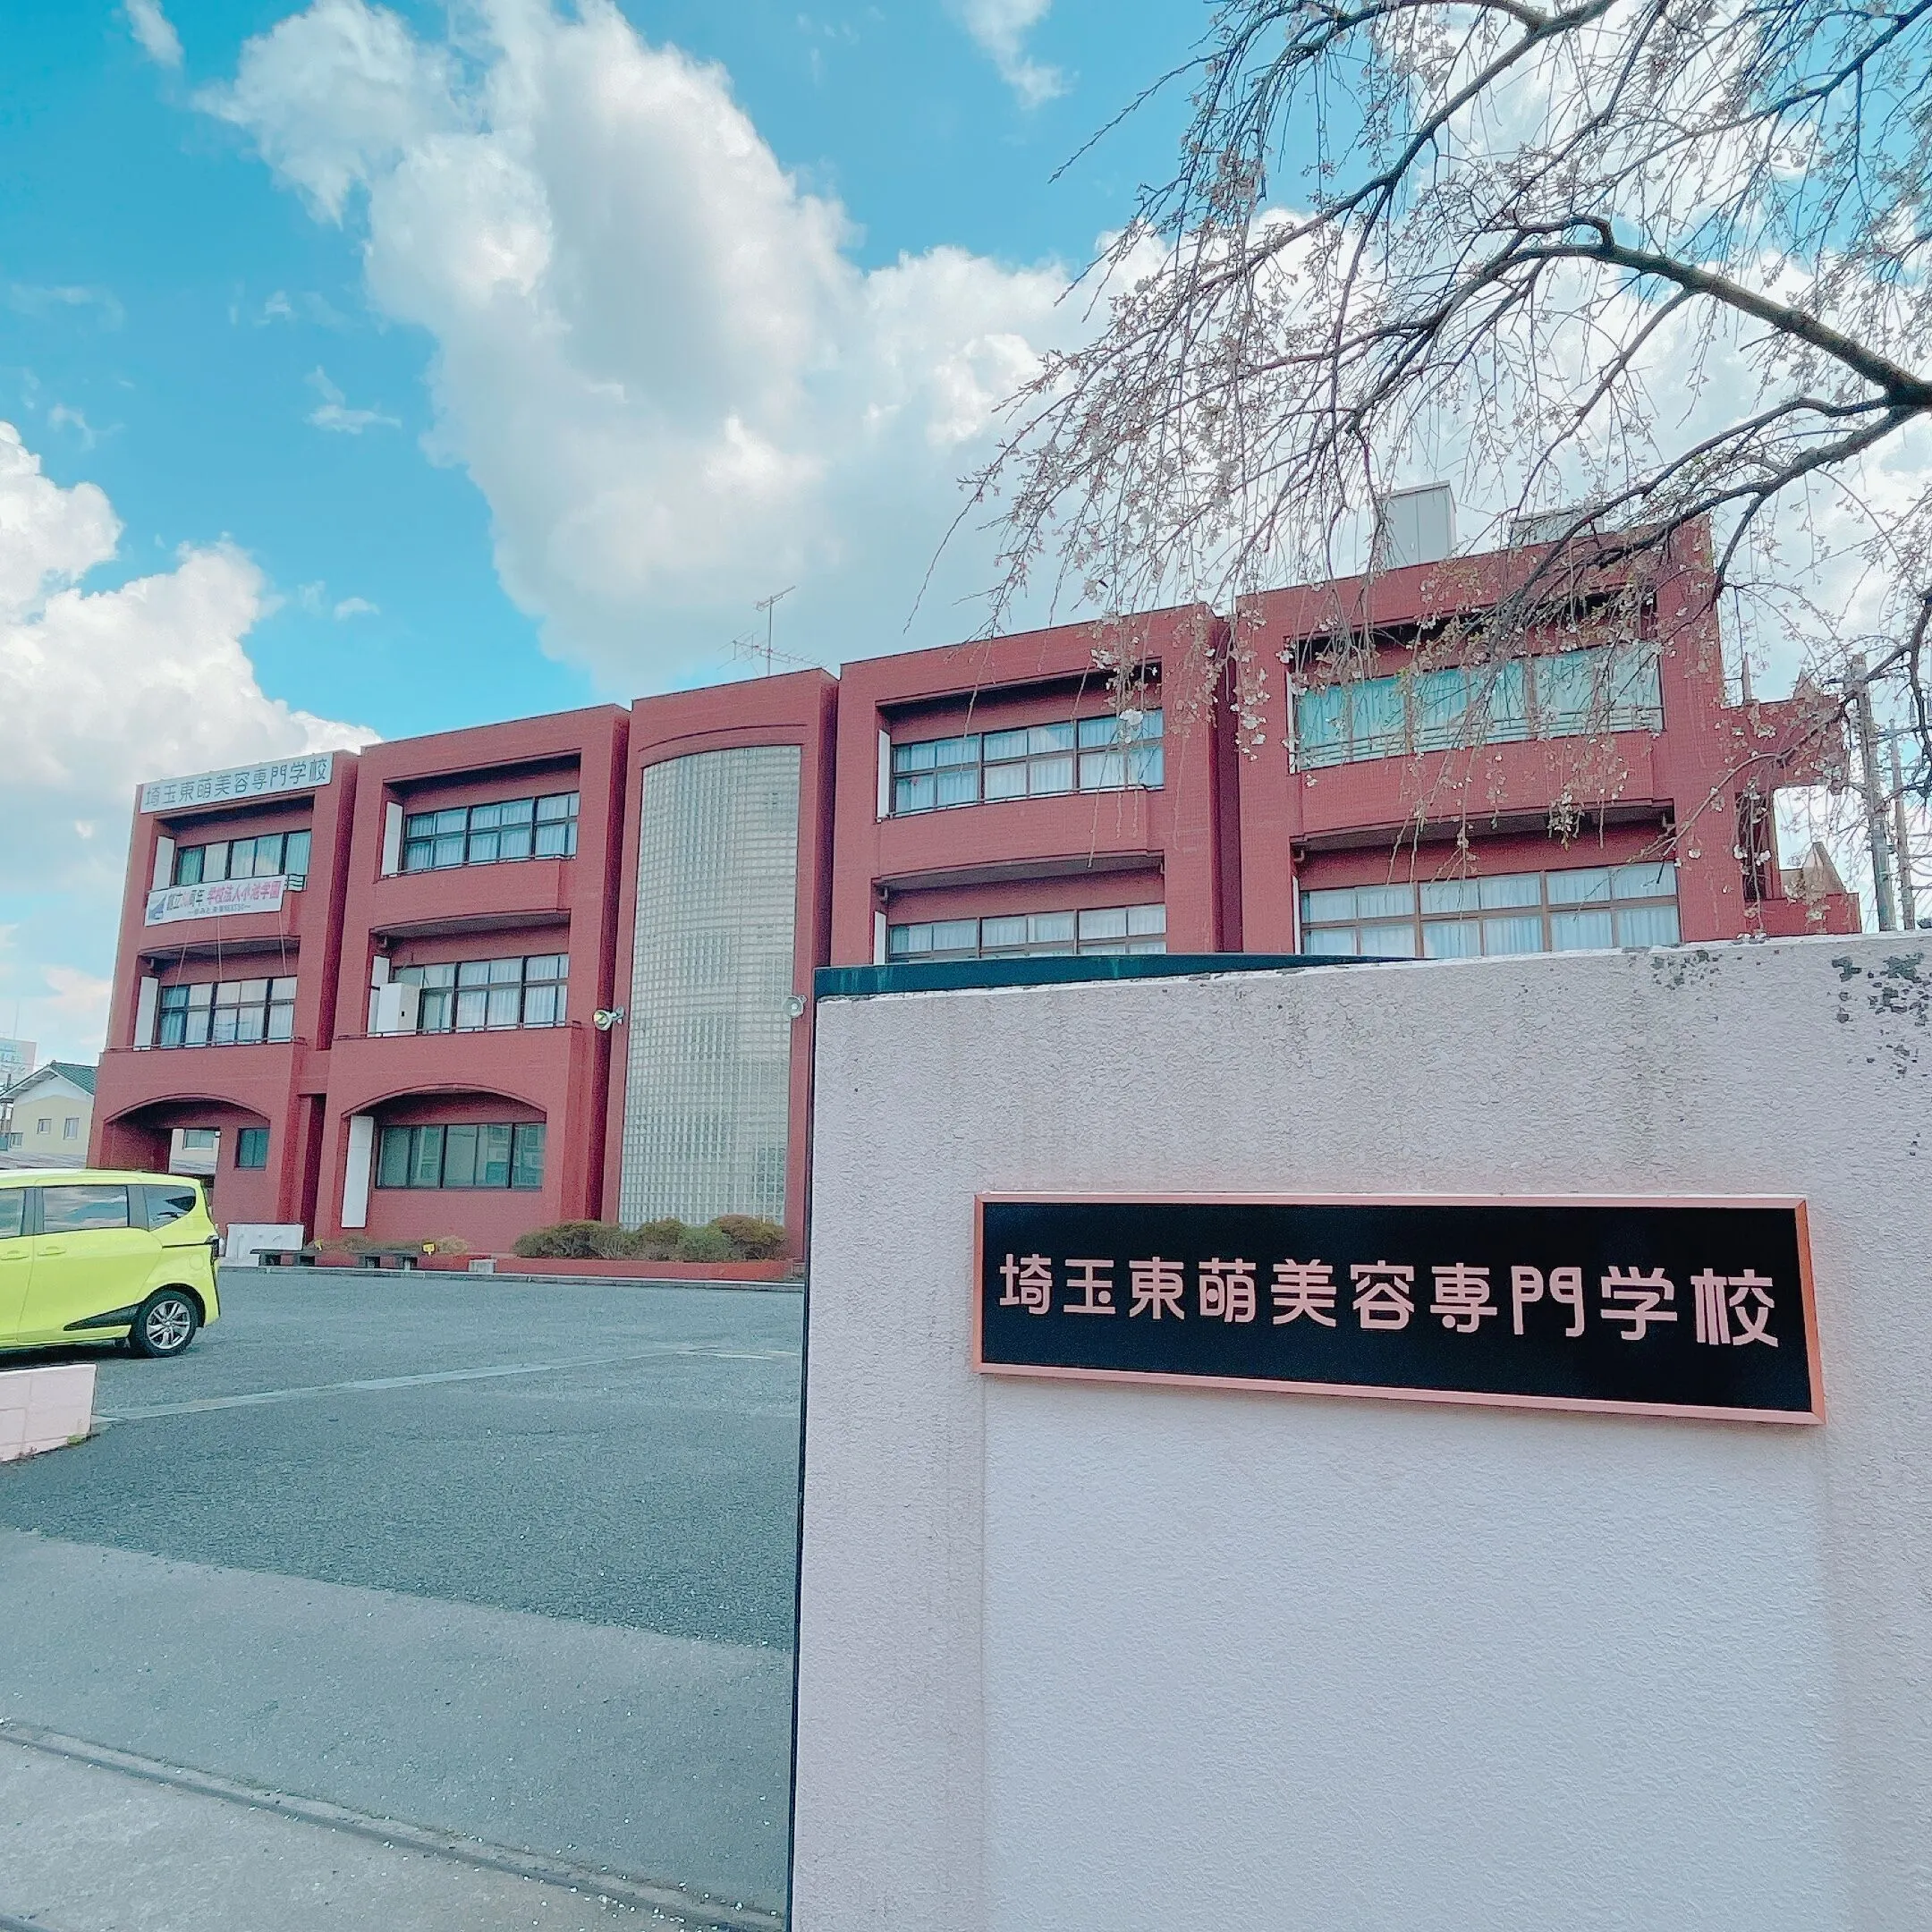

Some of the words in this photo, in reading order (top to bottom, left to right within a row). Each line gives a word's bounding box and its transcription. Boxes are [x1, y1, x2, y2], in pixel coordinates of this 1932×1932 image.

[145, 758, 327, 807] 埼玉東萌美容専門学校
[999, 1253, 1778, 1347] 埼玉東萌美容専門学校
